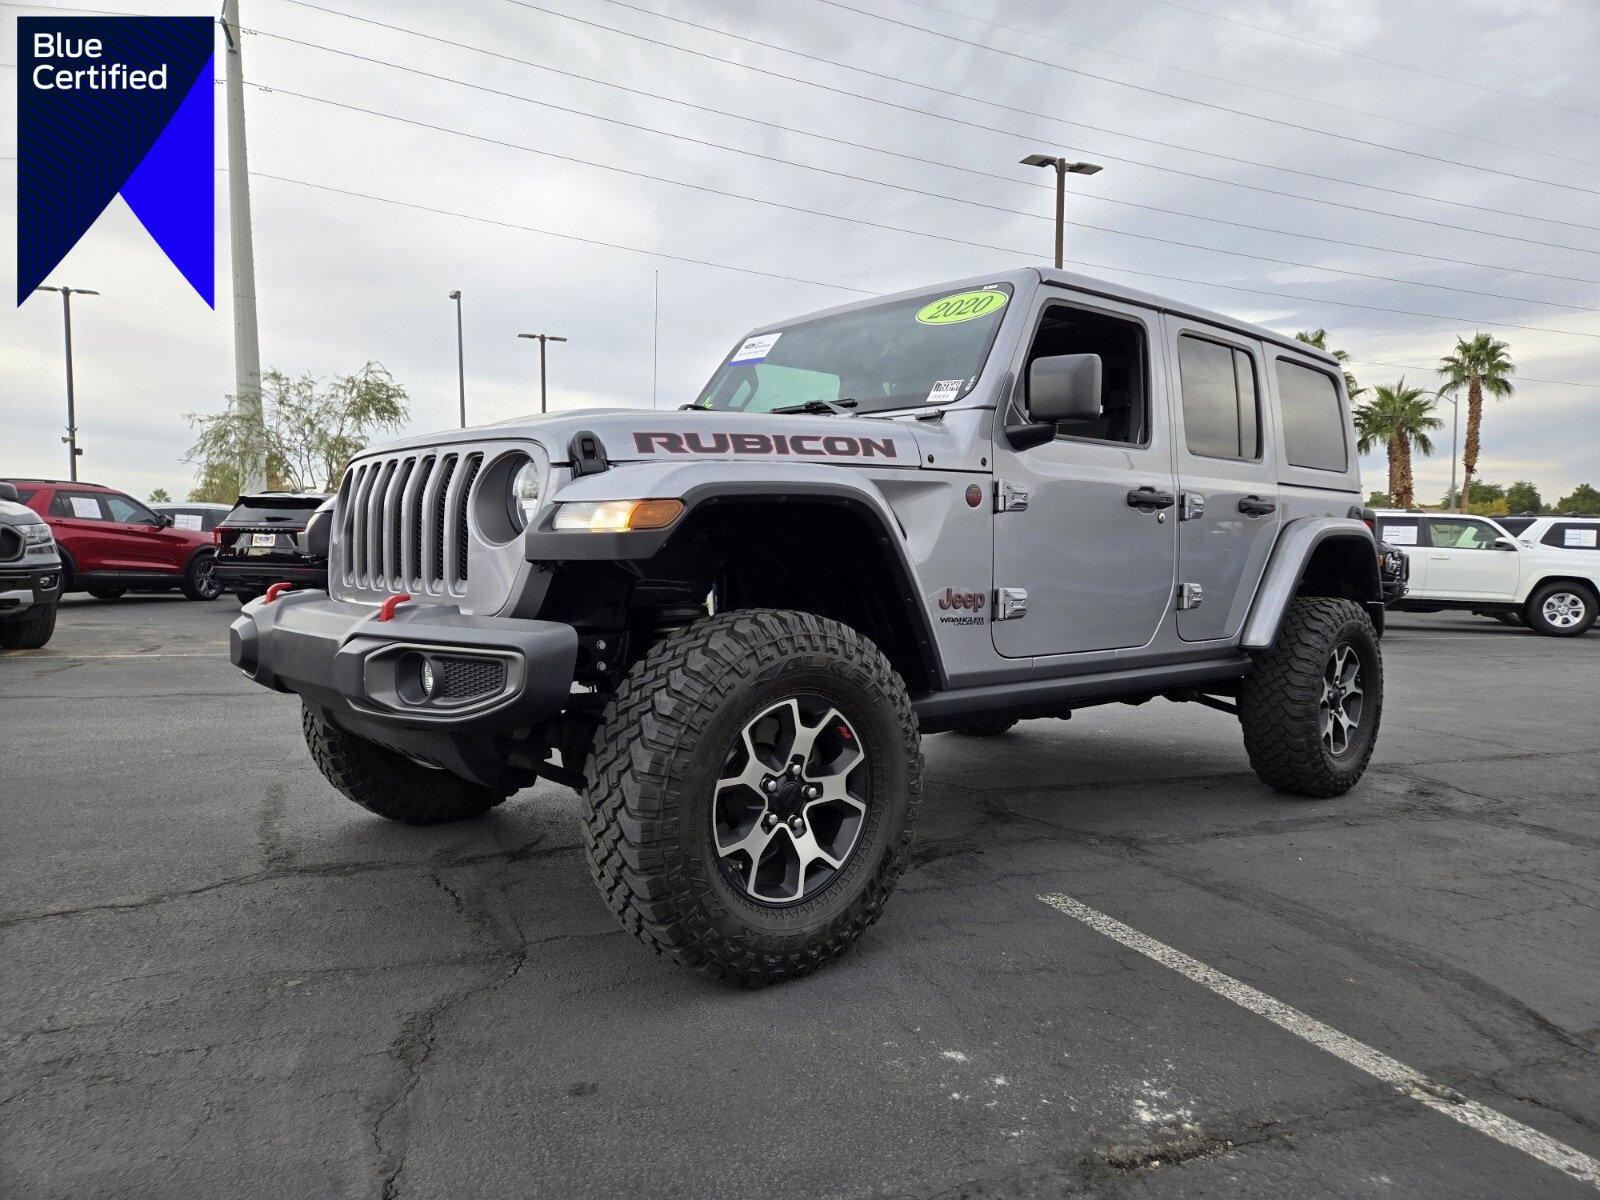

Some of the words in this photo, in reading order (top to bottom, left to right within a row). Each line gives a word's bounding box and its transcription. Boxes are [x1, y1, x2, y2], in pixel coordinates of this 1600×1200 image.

[926, 295, 995, 320] 2020
[632, 432, 898, 458] RUBICON
[938, 587, 986, 613] Jeep
